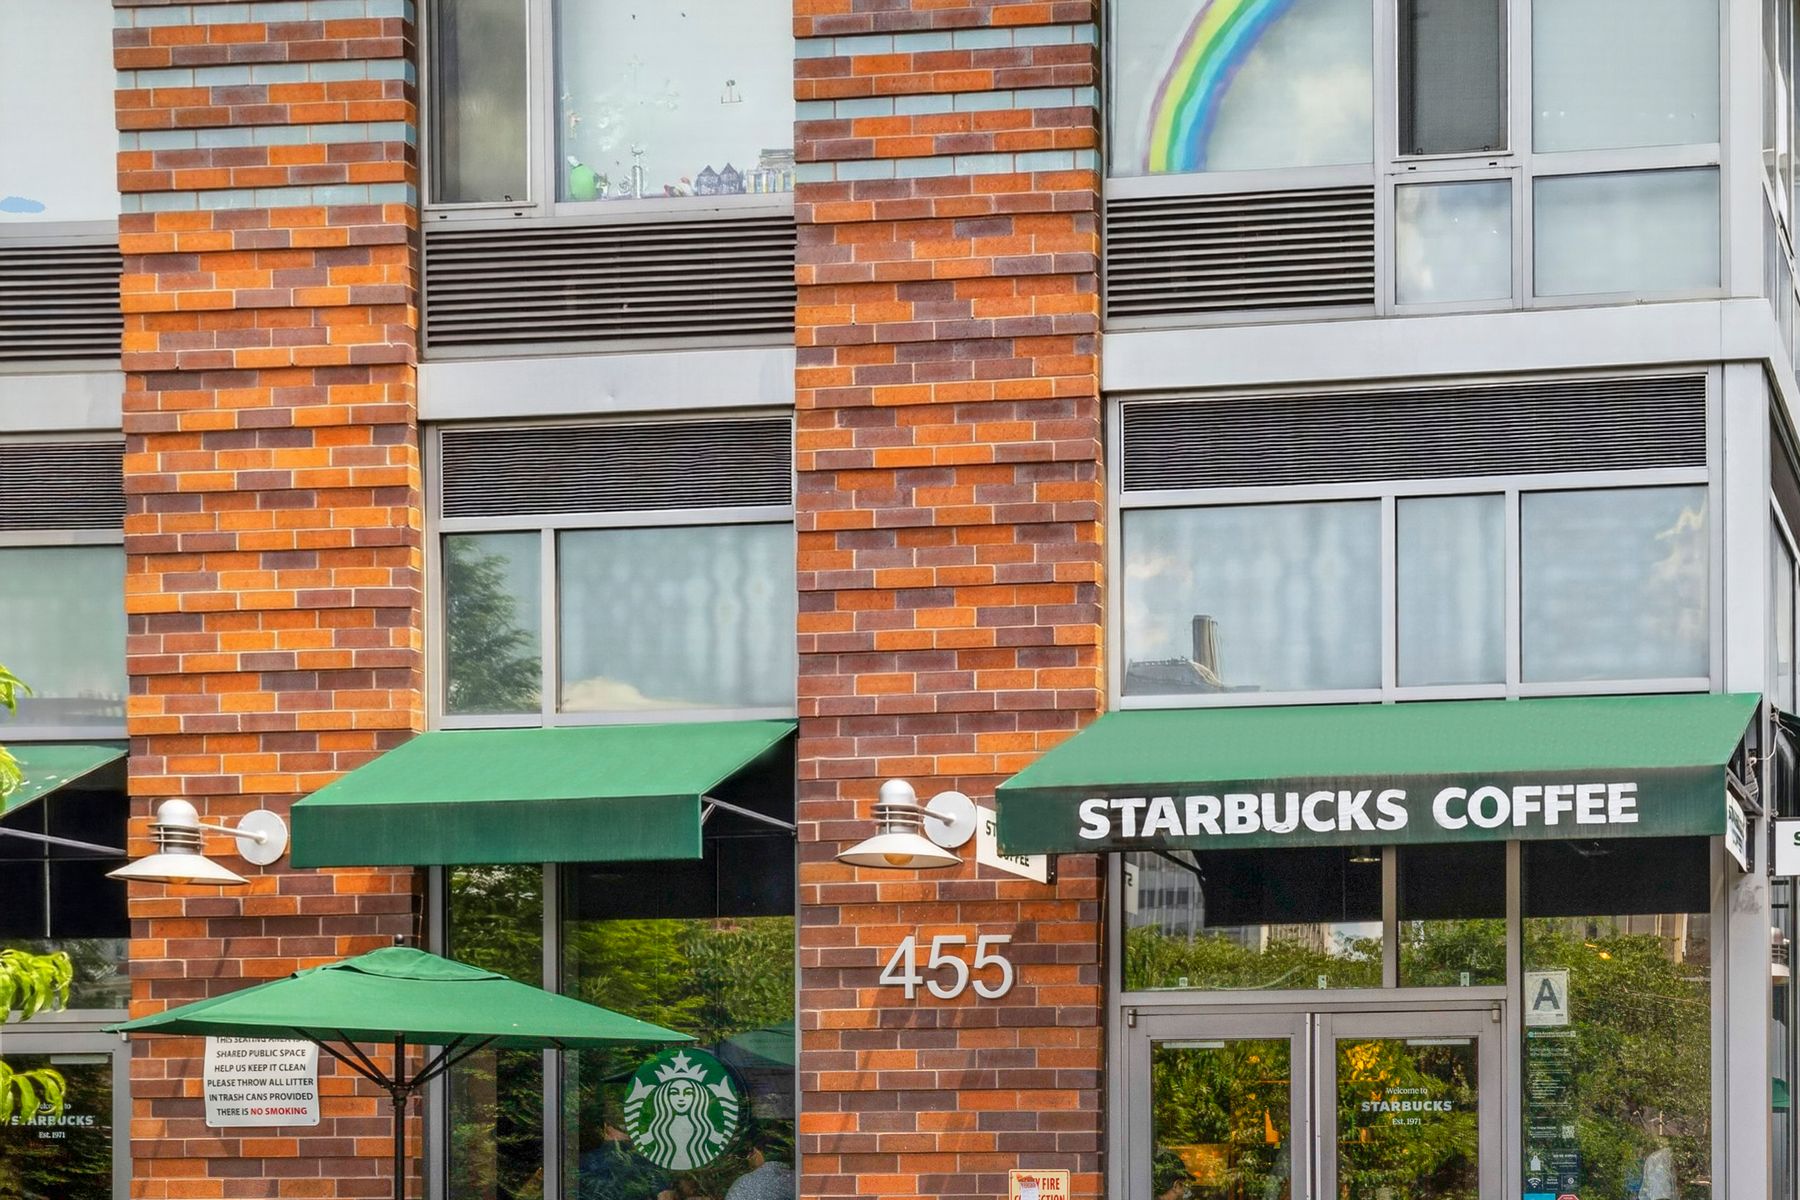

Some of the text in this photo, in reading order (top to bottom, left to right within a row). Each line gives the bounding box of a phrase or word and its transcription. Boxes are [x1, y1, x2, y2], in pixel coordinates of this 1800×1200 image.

[1079, 782, 1638, 839] STARBUCKS COFFEE
[880, 935, 1013, 999] 455
[1533, 978, 1560, 1010] A
[217, 1050, 247, 1058] SHARED
[280, 1049, 306, 1057] SPACE
[236, 1064, 246, 1072] US
[248, 1064, 268, 1072] KEEP
[208, 1079, 236, 1087] PLEASE
[269, 1078, 284, 1086] ALL
[286, 1078, 314, 1086] LITTER
[1386, 1087, 1420, 1095] Welcome
[219, 1093, 244, 1101] TRASH
[246, 1093, 267, 1101] CANS
[1362, 1101, 1452, 1112] STARBUCKS
[217, 1108, 240, 1116] THERE
[265, 1107, 307, 1115] SMOKING
[1042, 1178, 1060, 1190] FIRE
